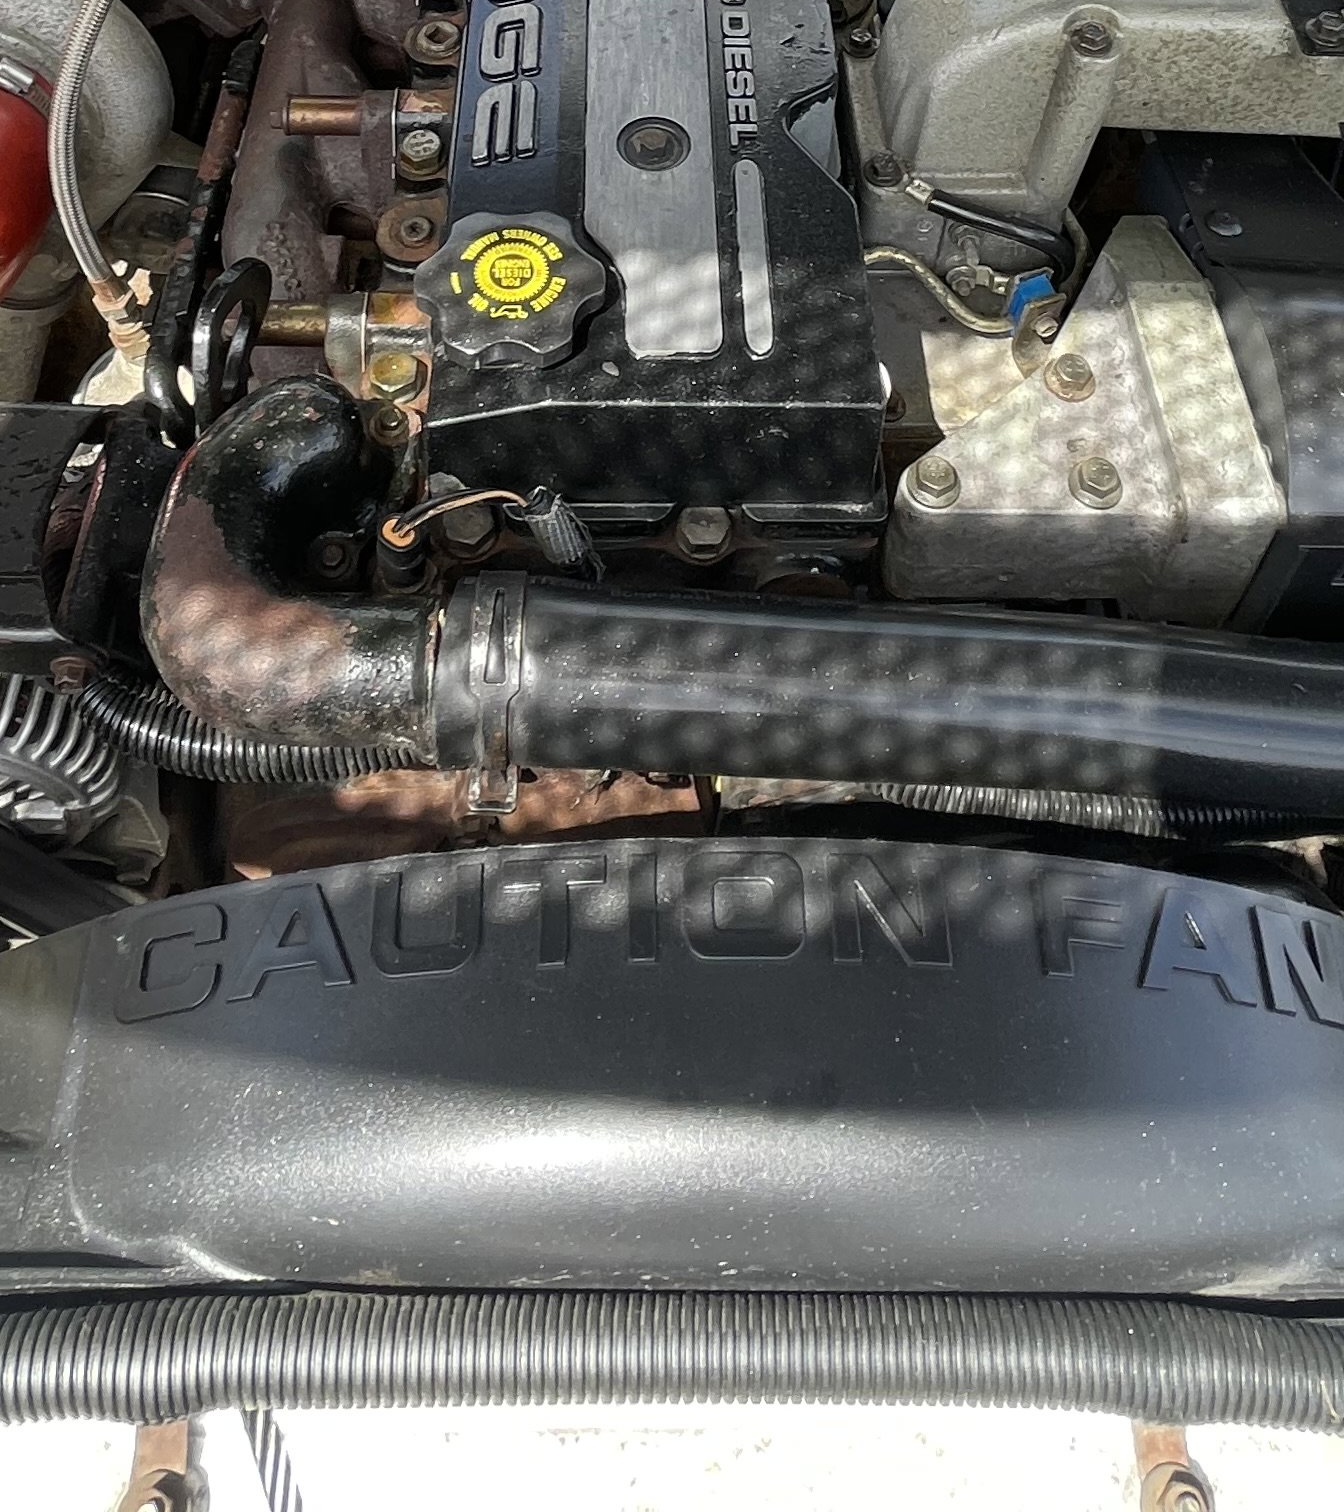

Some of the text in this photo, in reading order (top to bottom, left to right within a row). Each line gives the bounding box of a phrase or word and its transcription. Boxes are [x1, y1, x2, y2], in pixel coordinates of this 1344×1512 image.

[720, 9, 759, 148] DIESEL
[491, 268, 532, 279] DIESEL
[108, 845, 955, 1027] CAUTION
